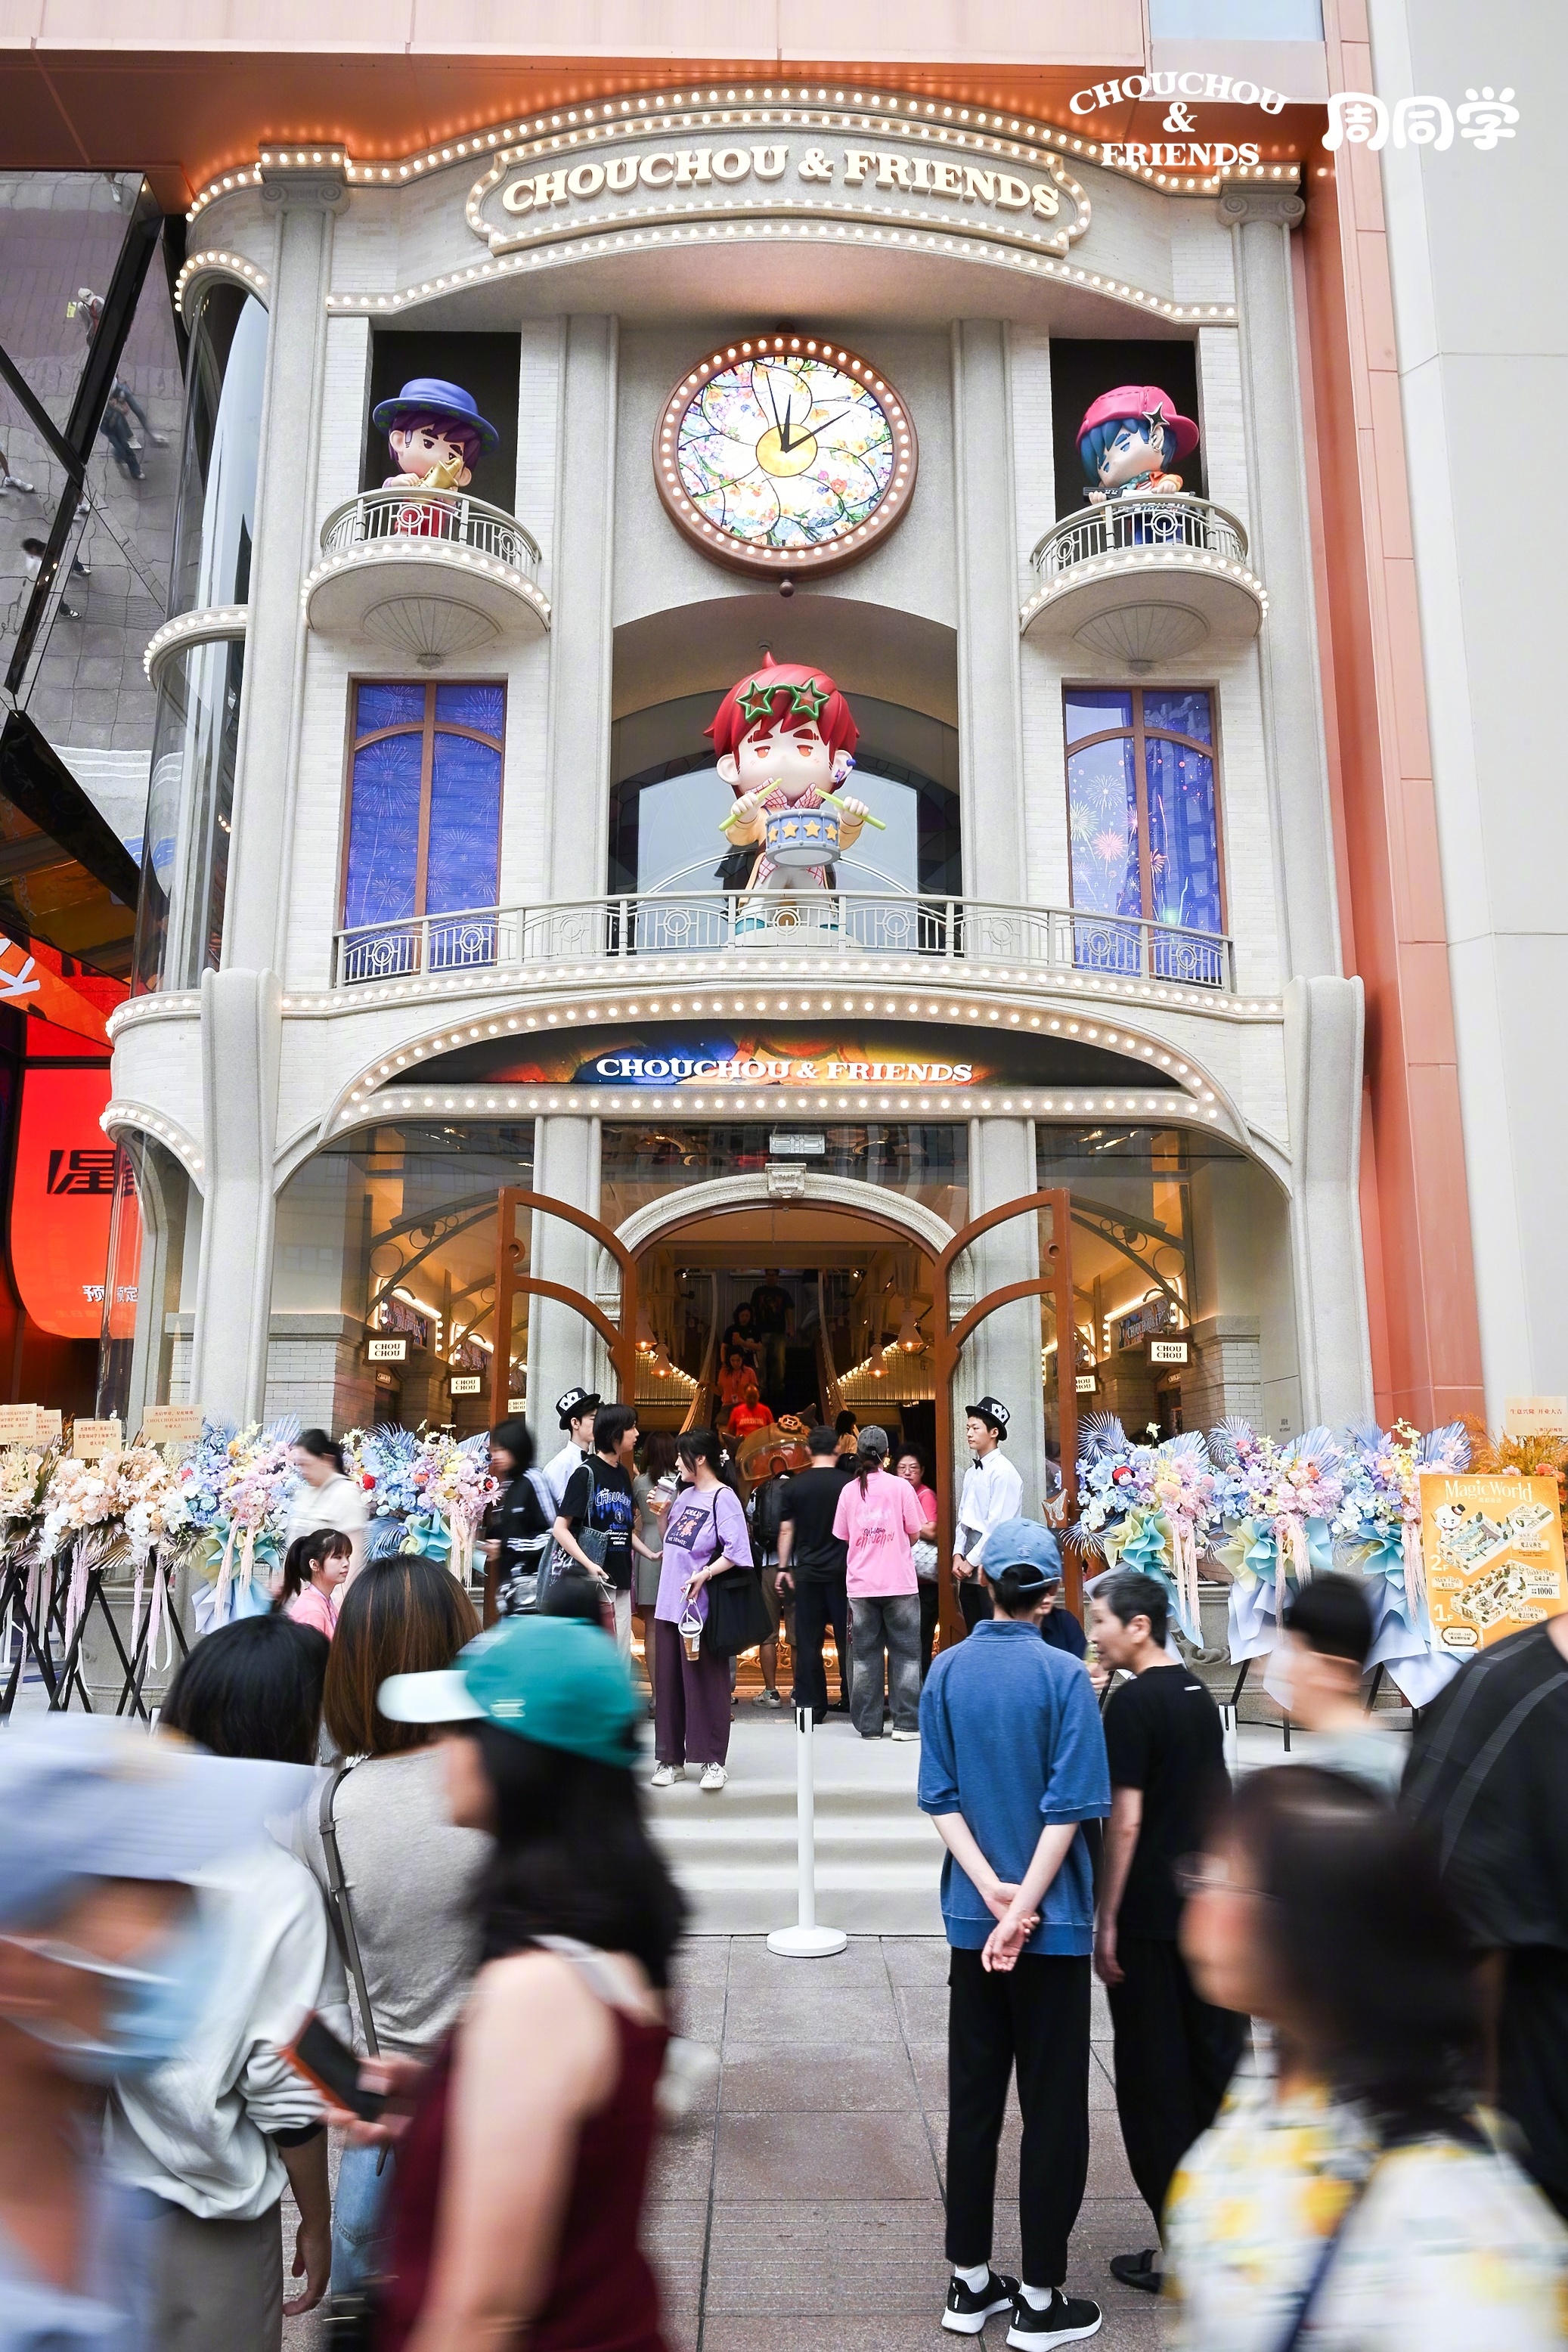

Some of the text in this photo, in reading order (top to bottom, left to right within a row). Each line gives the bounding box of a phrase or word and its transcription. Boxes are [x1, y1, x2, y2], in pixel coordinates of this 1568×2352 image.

[503, 145, 1060, 219] CHOUCHOU & FRIENDS
[597, 1058, 973, 1082] CHOUCHOU & FRIENDS
[1430, 1554, 1449, 1572] 2F
[1433, 1604, 1454, 1622] 1F
